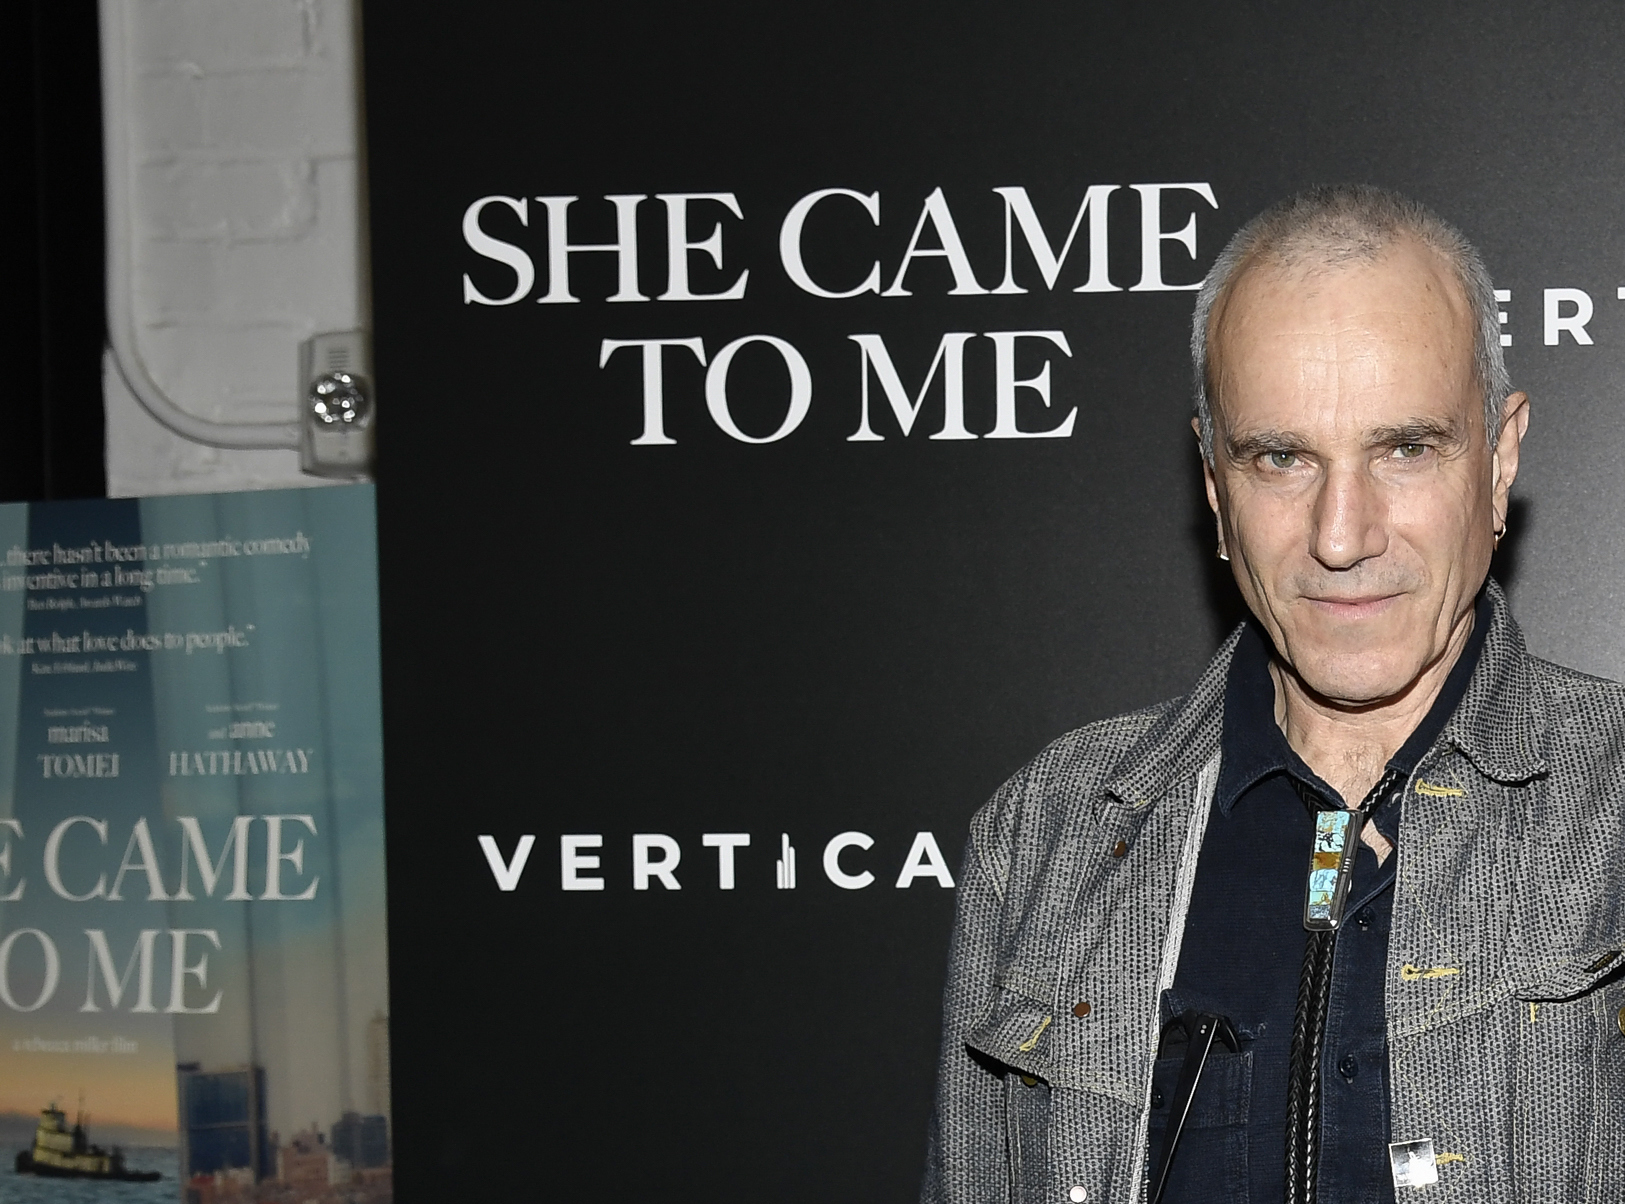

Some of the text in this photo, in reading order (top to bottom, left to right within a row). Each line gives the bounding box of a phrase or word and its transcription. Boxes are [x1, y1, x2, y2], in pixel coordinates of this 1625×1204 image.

[462, 182, 1219, 306] SHE CAME
[599, 330, 1078, 446] TO ME
[105, 540, 147, 562] been
[149, 544, 161, 560] a
[163, 534, 242, 558] romantic
[243, 531, 311, 560] comedy
[2, 567, 79, 591] inventive
[81, 566, 98, 588] in
[100, 570, 112, 587] a
[115, 565, 154, 593] long
[37, 631, 81, 654] what
[83, 629, 119, 652] love
[120, 629, 162, 651] does
[164, 631, 184, 650] to
[47, 719, 109, 743] marisa
[229, 721, 275, 739] anne
[36, 752, 120, 778] TOMEI
[169, 748, 314, 777] HATHAWAY
[43, 813, 319, 902] CAME
[477, 831, 956, 892] VERTICA
[0, 927, 223, 1015] O ME
